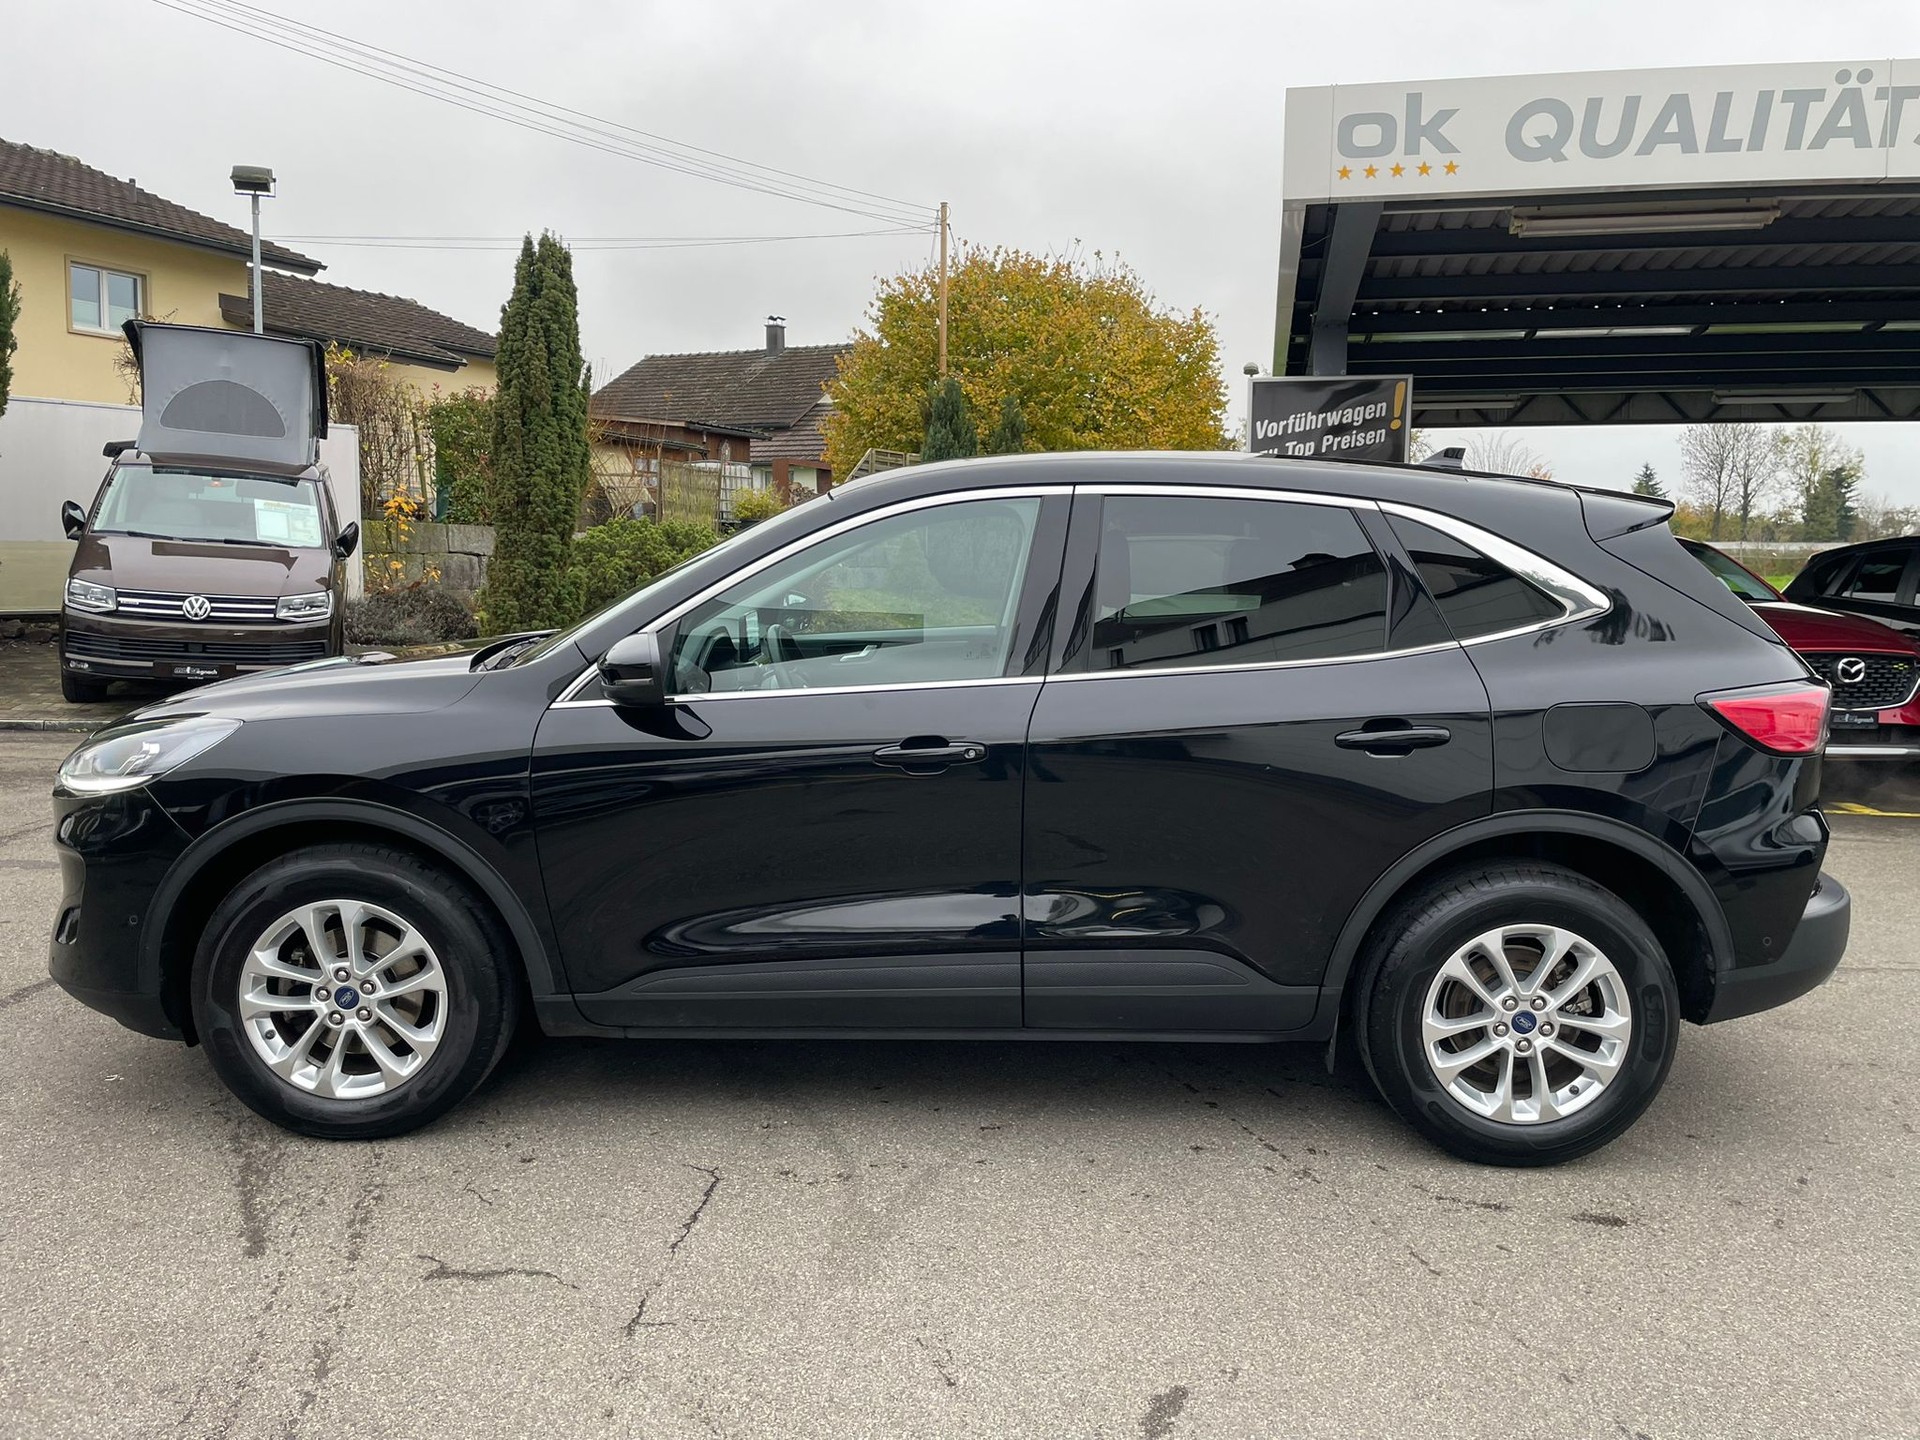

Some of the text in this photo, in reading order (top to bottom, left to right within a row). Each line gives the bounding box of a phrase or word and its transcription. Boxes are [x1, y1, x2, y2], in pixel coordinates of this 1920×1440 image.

[1337, 67, 1920, 163] ok QUALITÄT
[1255, 401, 1387, 440] Vorführwagen
[1285, 440, 1316, 457] Top
[1321, 428, 1386, 453] Preisen
